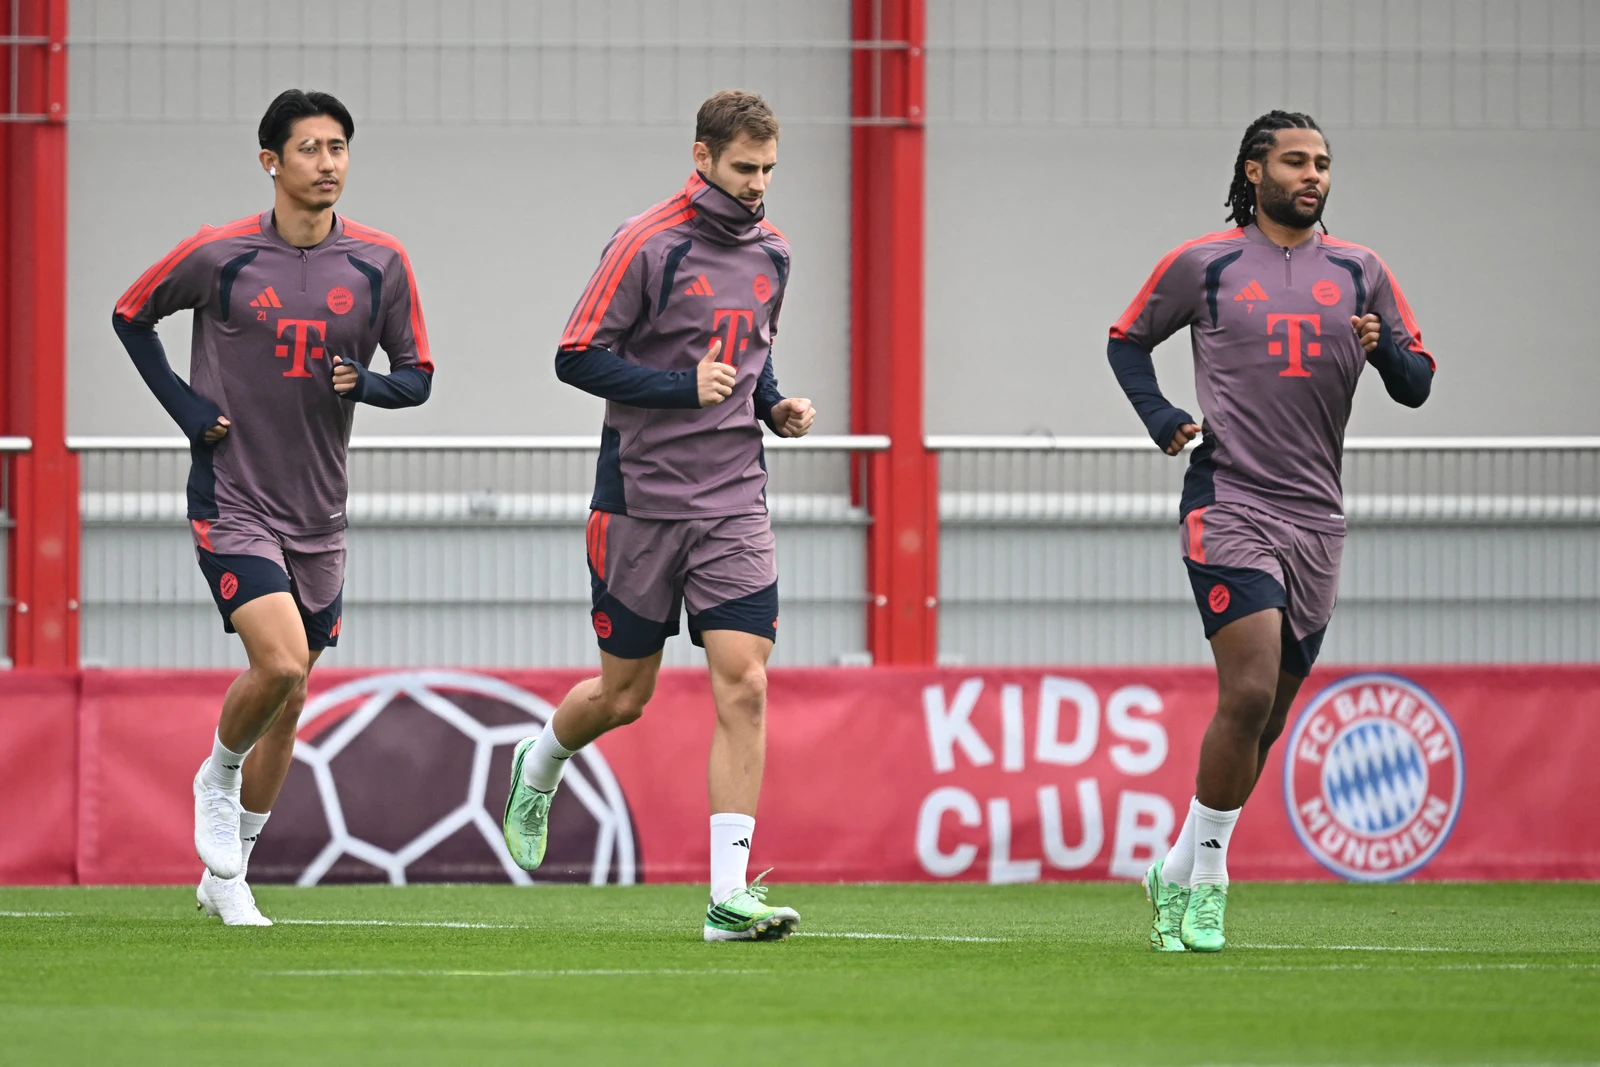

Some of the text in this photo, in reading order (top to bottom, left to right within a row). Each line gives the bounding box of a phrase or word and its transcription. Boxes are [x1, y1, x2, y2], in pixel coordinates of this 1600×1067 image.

[256, 310, 267, 321] 21
[1246, 303, 1254, 314] 7
[275, 318, 327, 378] T
[1266, 313, 1321, 377] T
[922, 675, 1169, 776] KIDS
[1299, 686, 1451, 765] FC BAYERN
[914, 777, 1176, 885] CLUB
